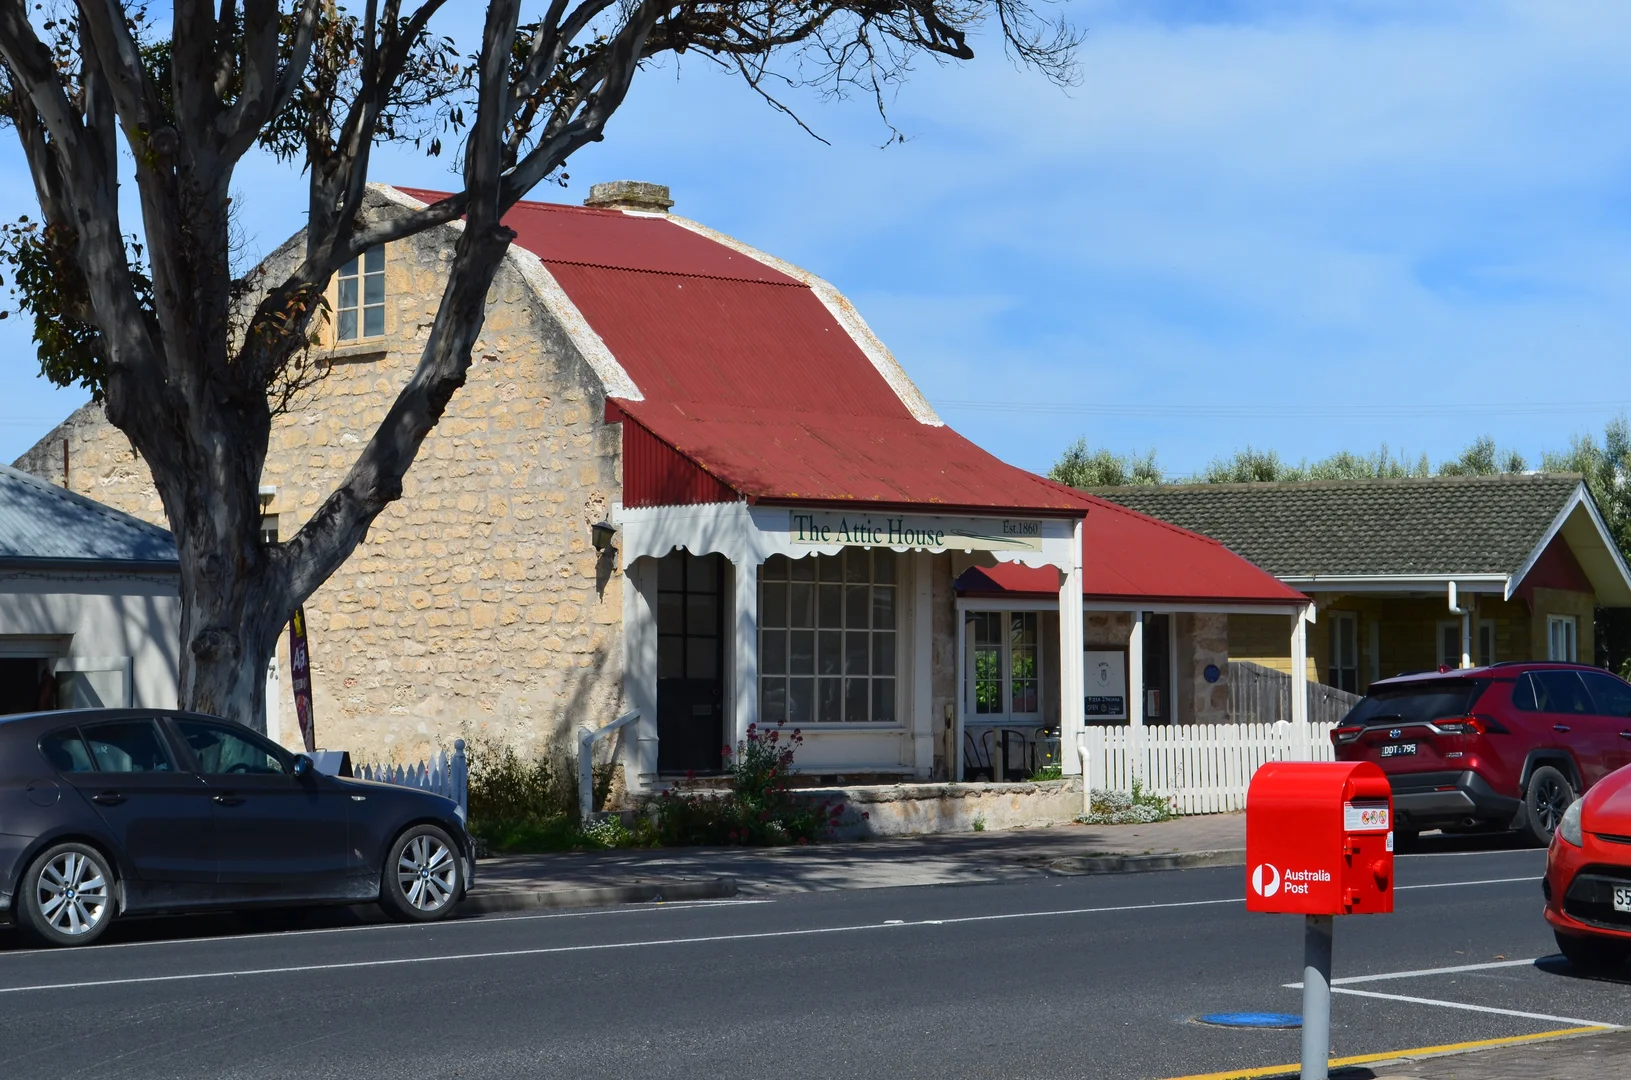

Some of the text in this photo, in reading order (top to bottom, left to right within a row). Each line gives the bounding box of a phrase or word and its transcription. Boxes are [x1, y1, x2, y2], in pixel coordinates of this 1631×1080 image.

[793, 515, 945, 546] The Attic House
[1003, 521, 1038, 535] Est.1860
[1284, 868, 1331, 882] Australia
[1284, 882, 1309, 894] Post
